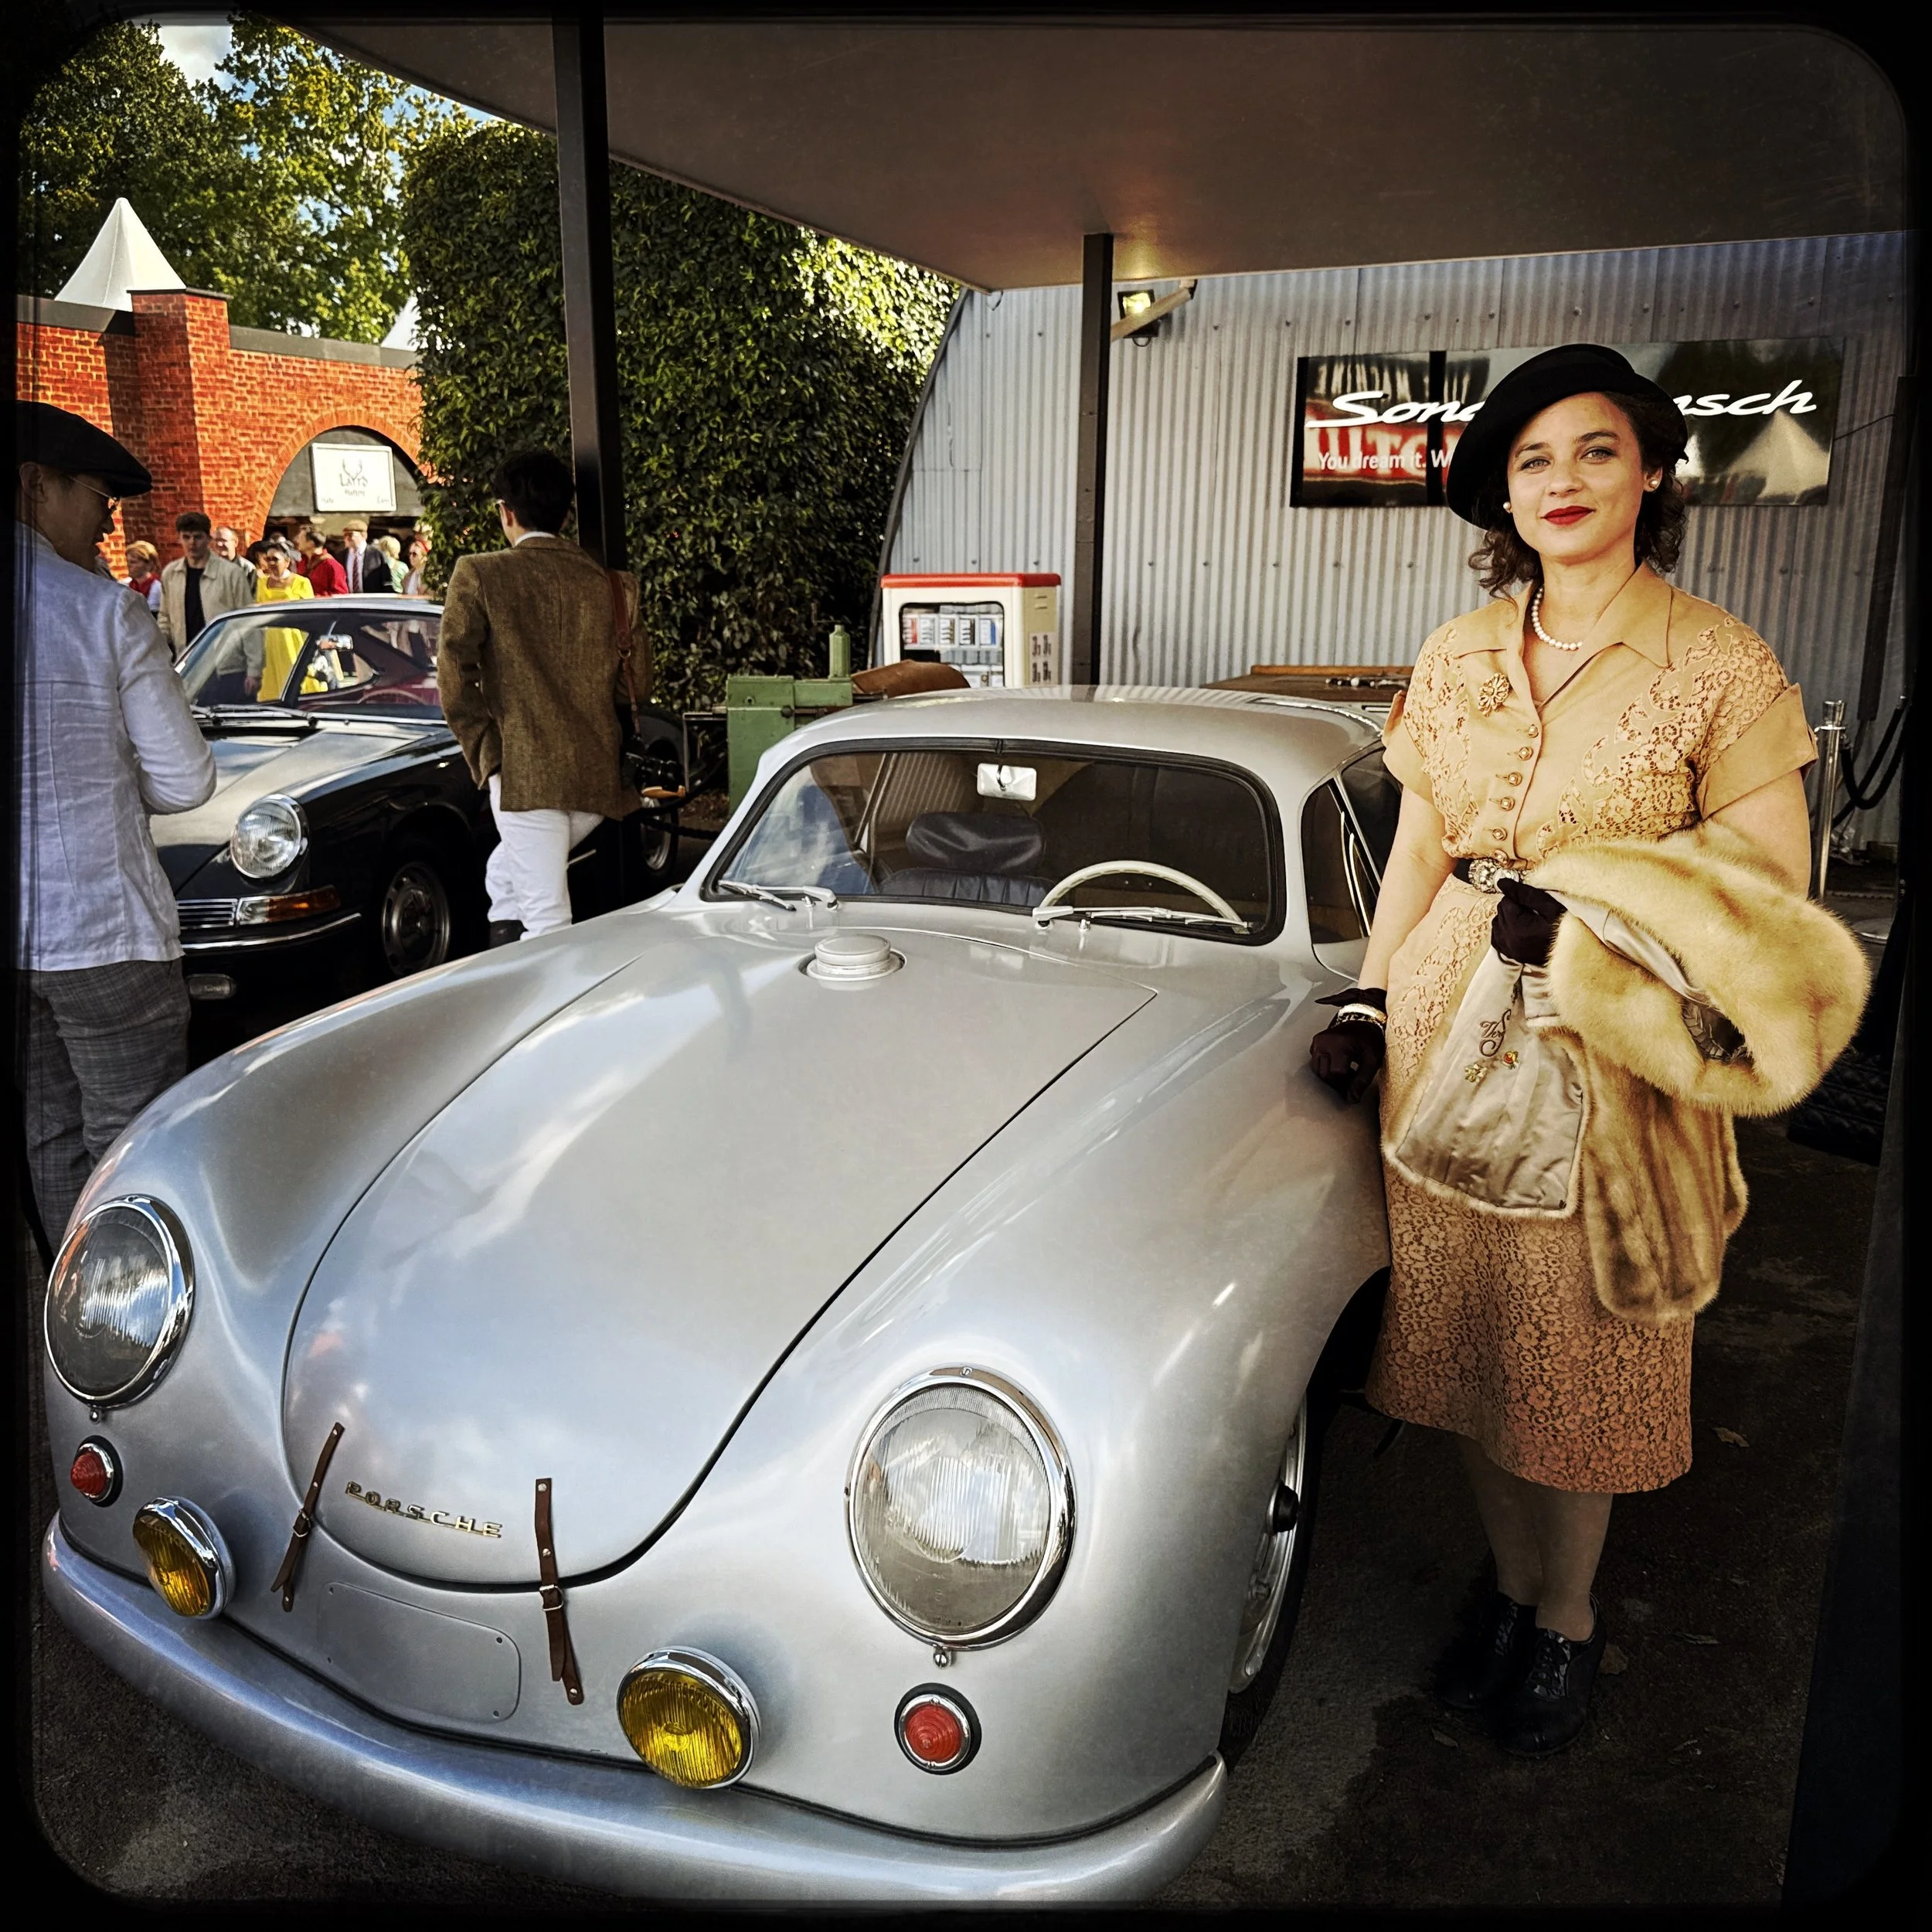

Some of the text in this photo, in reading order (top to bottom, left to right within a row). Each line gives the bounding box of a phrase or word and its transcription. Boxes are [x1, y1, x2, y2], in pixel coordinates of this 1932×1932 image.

[1318, 448, 1452, 471] You dream it. W
[345, 1480, 503, 1539] PORSCHE
